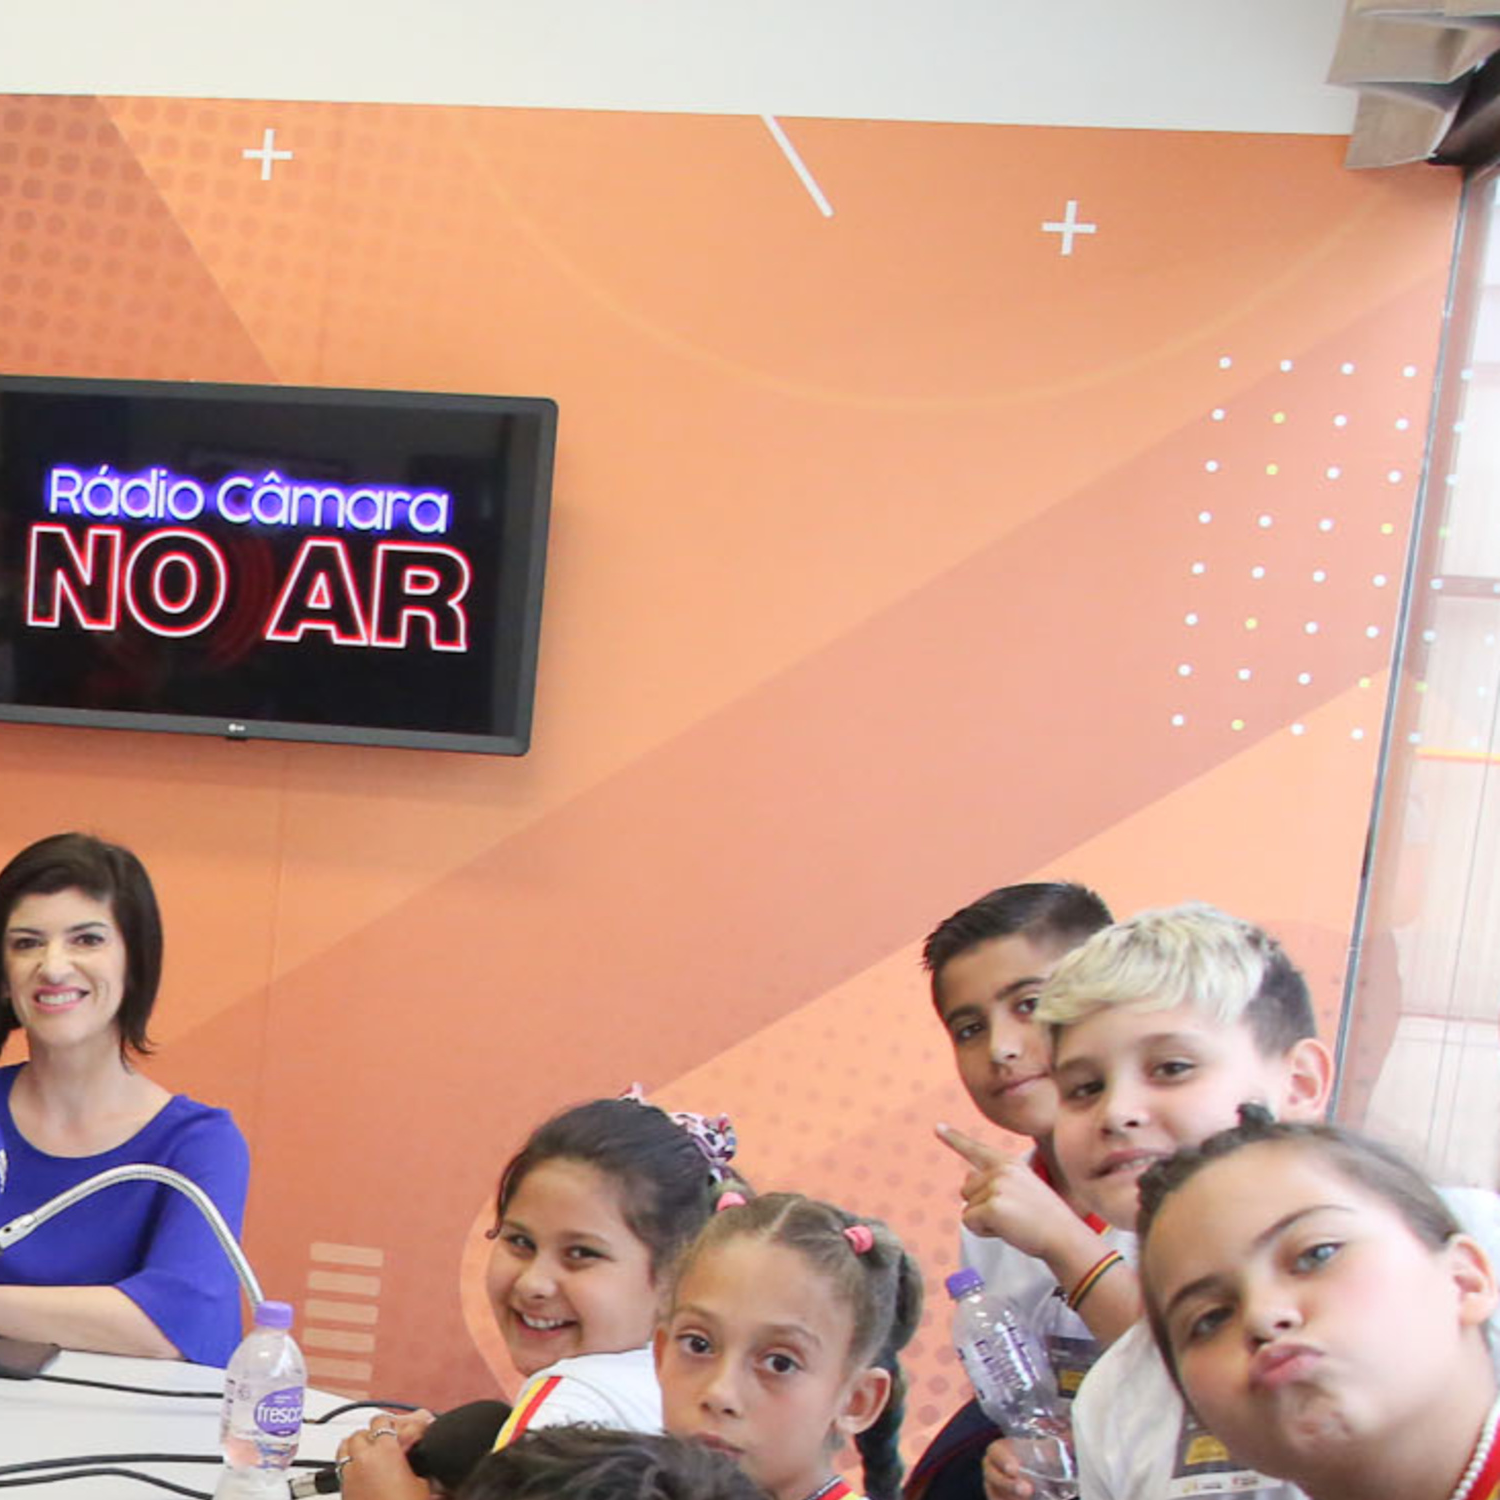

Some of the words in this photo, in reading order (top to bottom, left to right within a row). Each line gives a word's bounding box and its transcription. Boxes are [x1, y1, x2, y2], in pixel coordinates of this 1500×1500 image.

[49, 465, 203, 521] Rádio
[216, 470, 449, 534] Câmara
[26, 525, 227, 638] NO
[265, 537, 471, 652] AR
[257, 1402, 303, 1424] frescc
